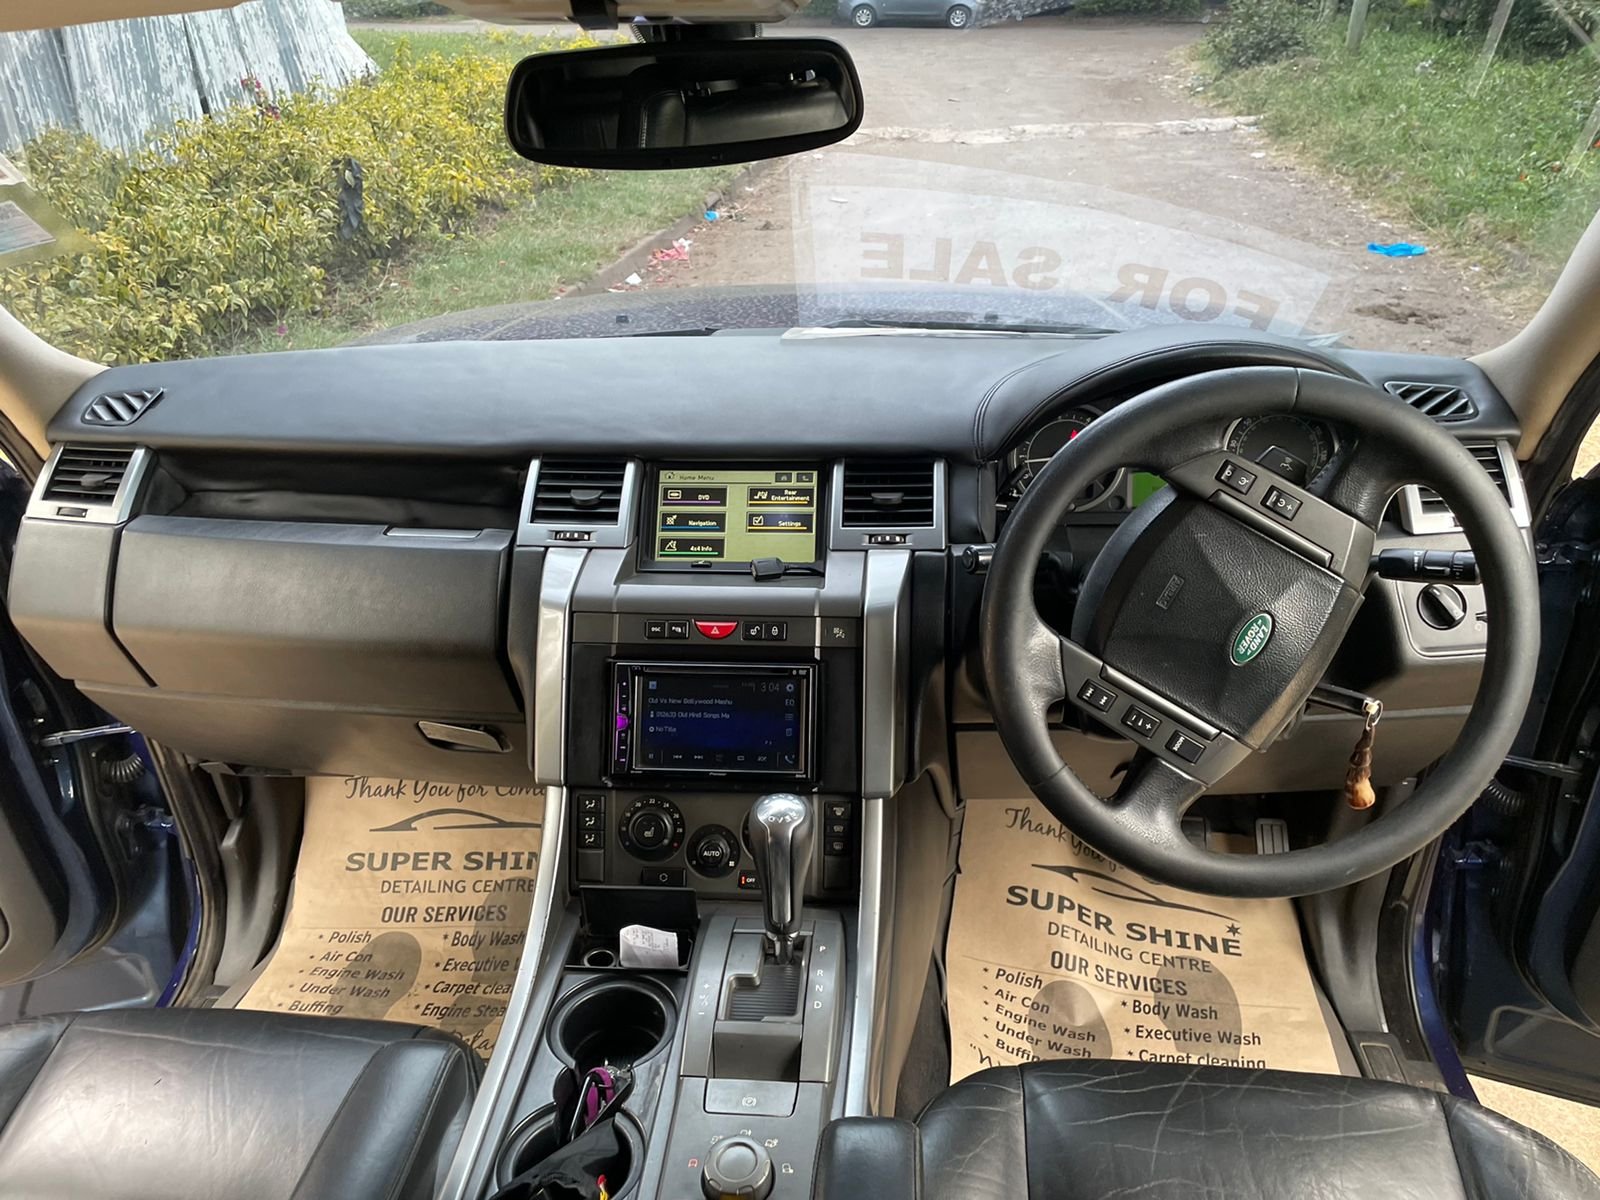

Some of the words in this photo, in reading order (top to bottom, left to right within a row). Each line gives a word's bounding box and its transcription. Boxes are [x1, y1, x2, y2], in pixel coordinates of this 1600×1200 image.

[1236, 622, 1260, 655] ROVER
[1250, 624, 1268, 652] LAND
[345, 775, 406, 799] Thank
[414, 779, 453, 803] You
[457, 783, 488, 802] for
[1004, 807, 1067, 842] Thank
[345, 852, 453, 872] SUPER
[381, 879, 466, 894] DETAILING
[472, 878, 534, 893] CENTRE
[381, 906, 418, 923] OUR
[423, 905, 508, 922] SERVICES
[1006, 885, 1116, 936] SUPER
[1126, 921, 1243, 957] SHINE
[328, 931, 372, 944] Polish
[451, 931, 485, 947] Body
[490, 931, 526, 945] Wash
[1047, 921, 1132, 961] DETAILING
[1140, 951, 1213, 974] CENTRE
[319, 951, 340, 962] Air
[345, 952, 374, 963] Con
[442, 958, 512, 972] Executive
[309, 967, 361, 980] Engine
[365, 969, 405, 981] Wash
[995, 967, 1043, 990] Polish
[1051, 950, 1089, 977] OUR
[1094, 964, 1188, 996] SERVICES
[300, 982, 345, 995] Under
[349, 986, 390, 998] Wash
[432, 981, 480, 995] Carpet
[484, 982, 513, 995] clea
[815, 984, 823, 992] N
[288, 1001, 344, 1015] Buffing
[813, 1001, 822, 1009] D
[994, 987, 1017, 1004] Air
[1021, 993, 1050, 1014] Con
[1132, 1000, 1169, 1020] Body
[1175, 1003, 1218, 1020] Wash
[421, 1003, 470, 1019] Engine
[995, 1002, 1047, 1032] Engine
[1052, 1023, 1096, 1042] Wash
[995, 1021, 1042, 1047] Under
[1047, 1040, 1092, 1058] Wash
[1135, 1025, 1212, 1043] Executive
[1217, 1031, 1261, 1046] Wash
[996, 1039, 1045, 1062] Buffin
